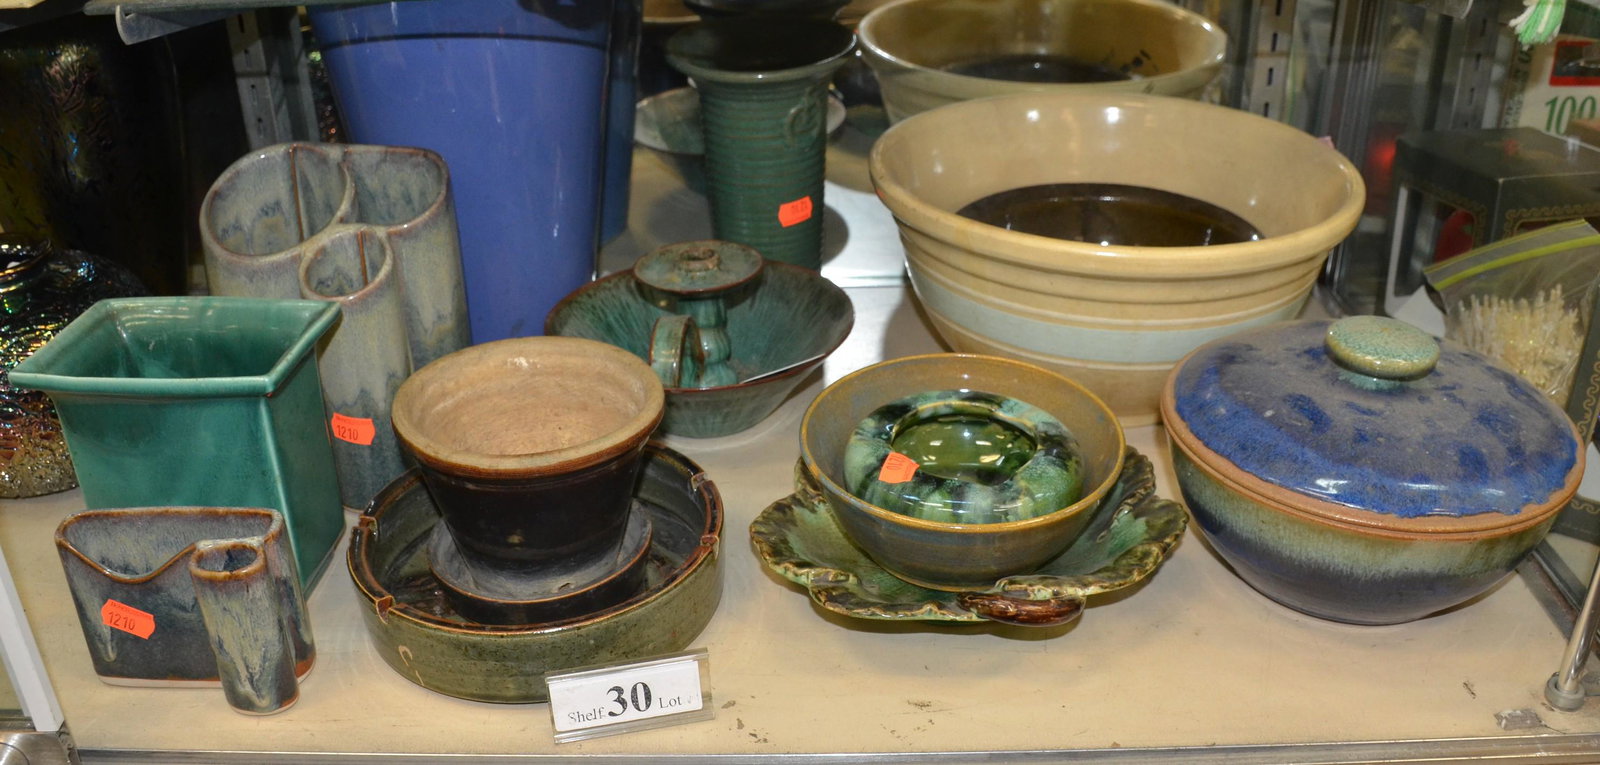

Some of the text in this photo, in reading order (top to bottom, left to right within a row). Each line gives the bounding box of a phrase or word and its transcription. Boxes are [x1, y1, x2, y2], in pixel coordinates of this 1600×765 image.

[336, 424, 359, 441] 1210
[108, 611, 136, 631] 1210
[567, 681, 683, 725] Shelf 30 Lot
